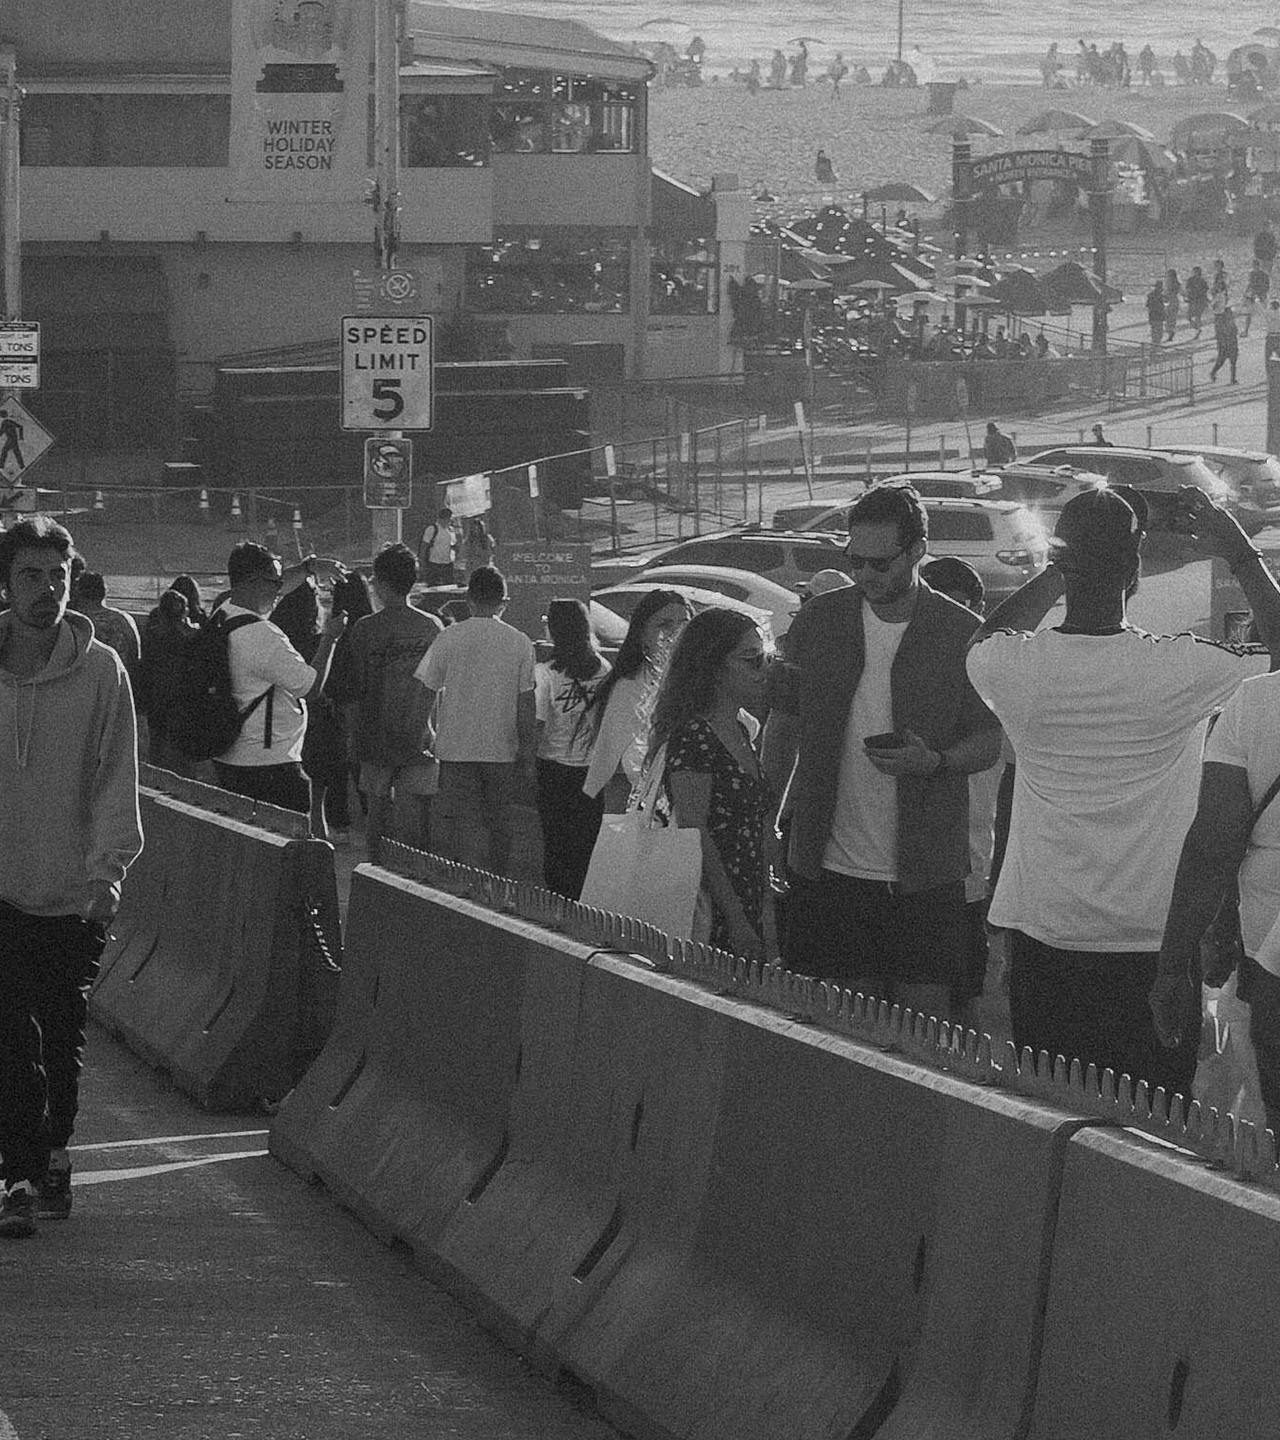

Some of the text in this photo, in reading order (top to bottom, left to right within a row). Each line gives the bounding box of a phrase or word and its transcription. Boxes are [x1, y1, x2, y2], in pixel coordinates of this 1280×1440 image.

[267, 121, 332, 135] WINTER
[264, 138, 335, 152] HOLIDAY
[265, 156, 332, 169] SEASON
[973, 154, 1092, 178] SANTA MONICA PIER
[347, 327, 427, 344] SPEED
[8, 343, 33, 351] TONS
[355, 354, 419, 370] LIMIT
[5, 375, 31, 383] TONS
[372, 379, 405, 420] 5
[512, 553, 574, 562] WELCOME
[535, 564, 550, 573] TO
[507, 575, 538, 583] ANTA
